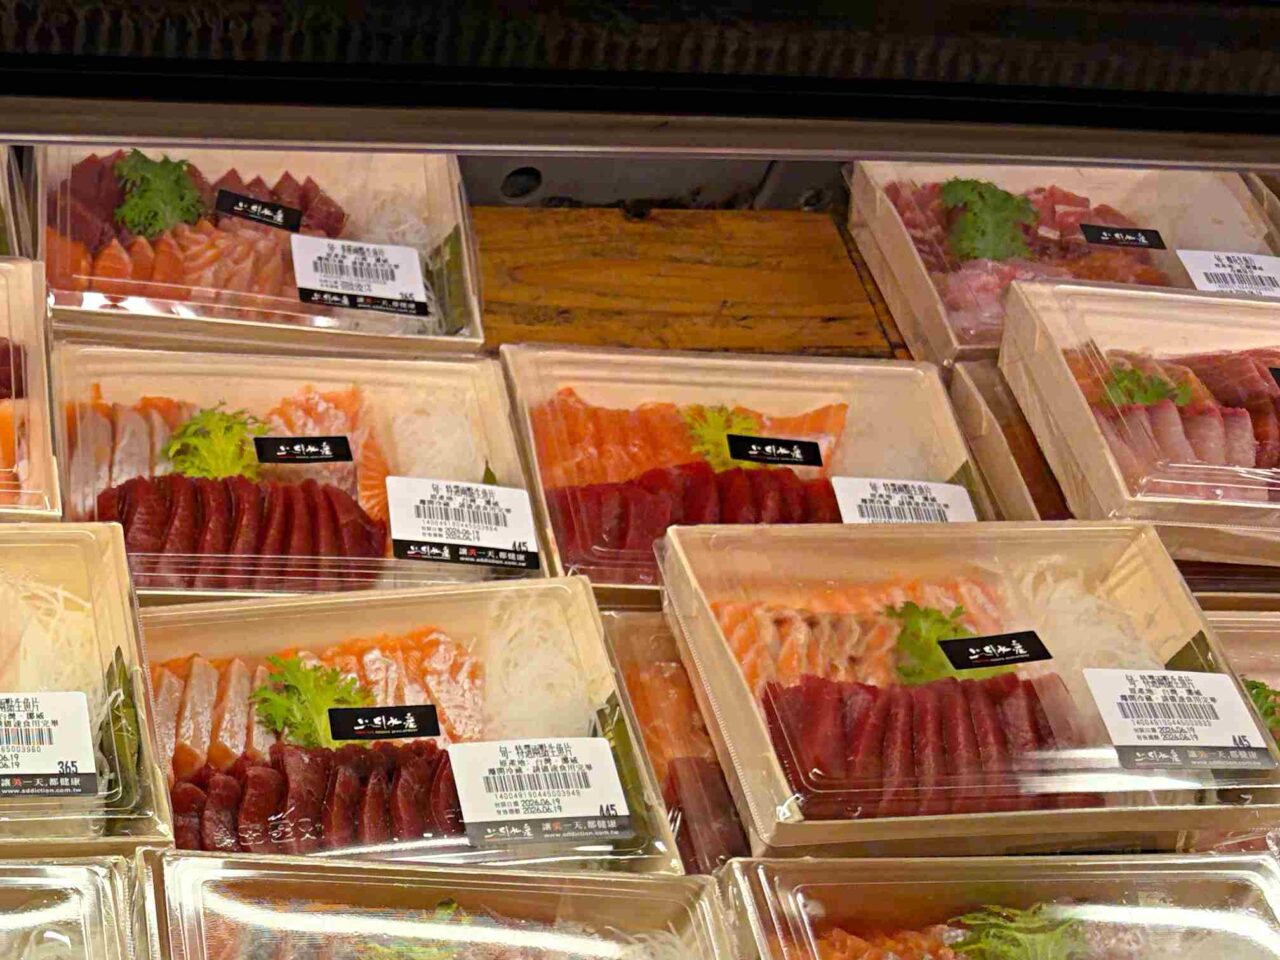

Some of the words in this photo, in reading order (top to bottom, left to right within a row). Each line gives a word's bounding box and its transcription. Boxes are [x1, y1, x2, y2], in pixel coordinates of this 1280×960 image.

[1232, 735, 1251, 747] 445
[58, 761, 78, 774] 365
[599, 804, 618, 816] 445
